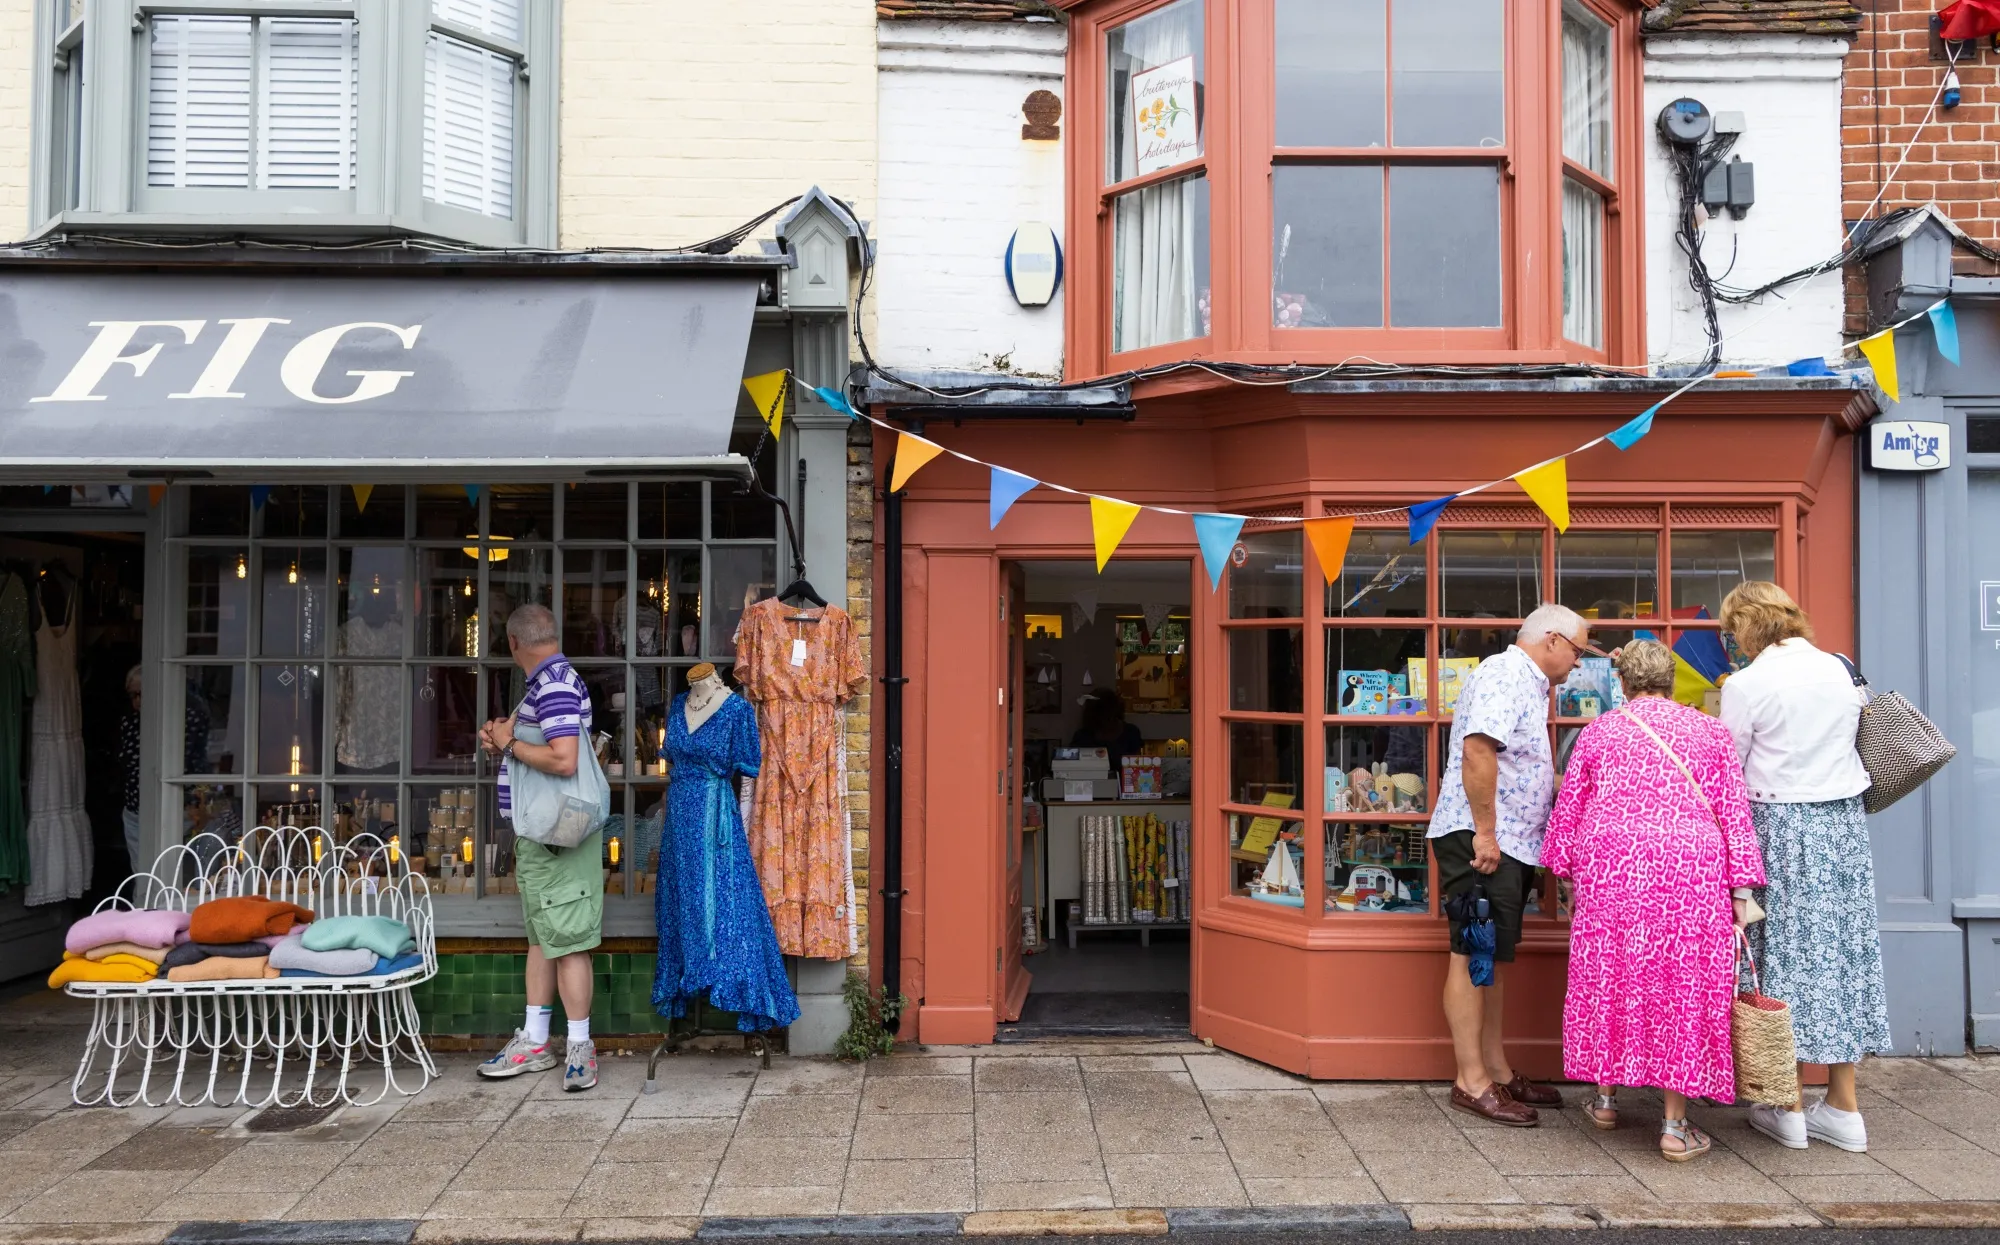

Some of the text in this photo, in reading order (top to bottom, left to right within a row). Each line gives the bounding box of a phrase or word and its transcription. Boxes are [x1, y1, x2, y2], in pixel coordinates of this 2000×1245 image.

[1138, 139, 1197, 162] holidays
[29, 317, 423, 404] FIG
[1883, 430, 1939, 455] Amiga
[1587, 659, 1610, 669] THE
